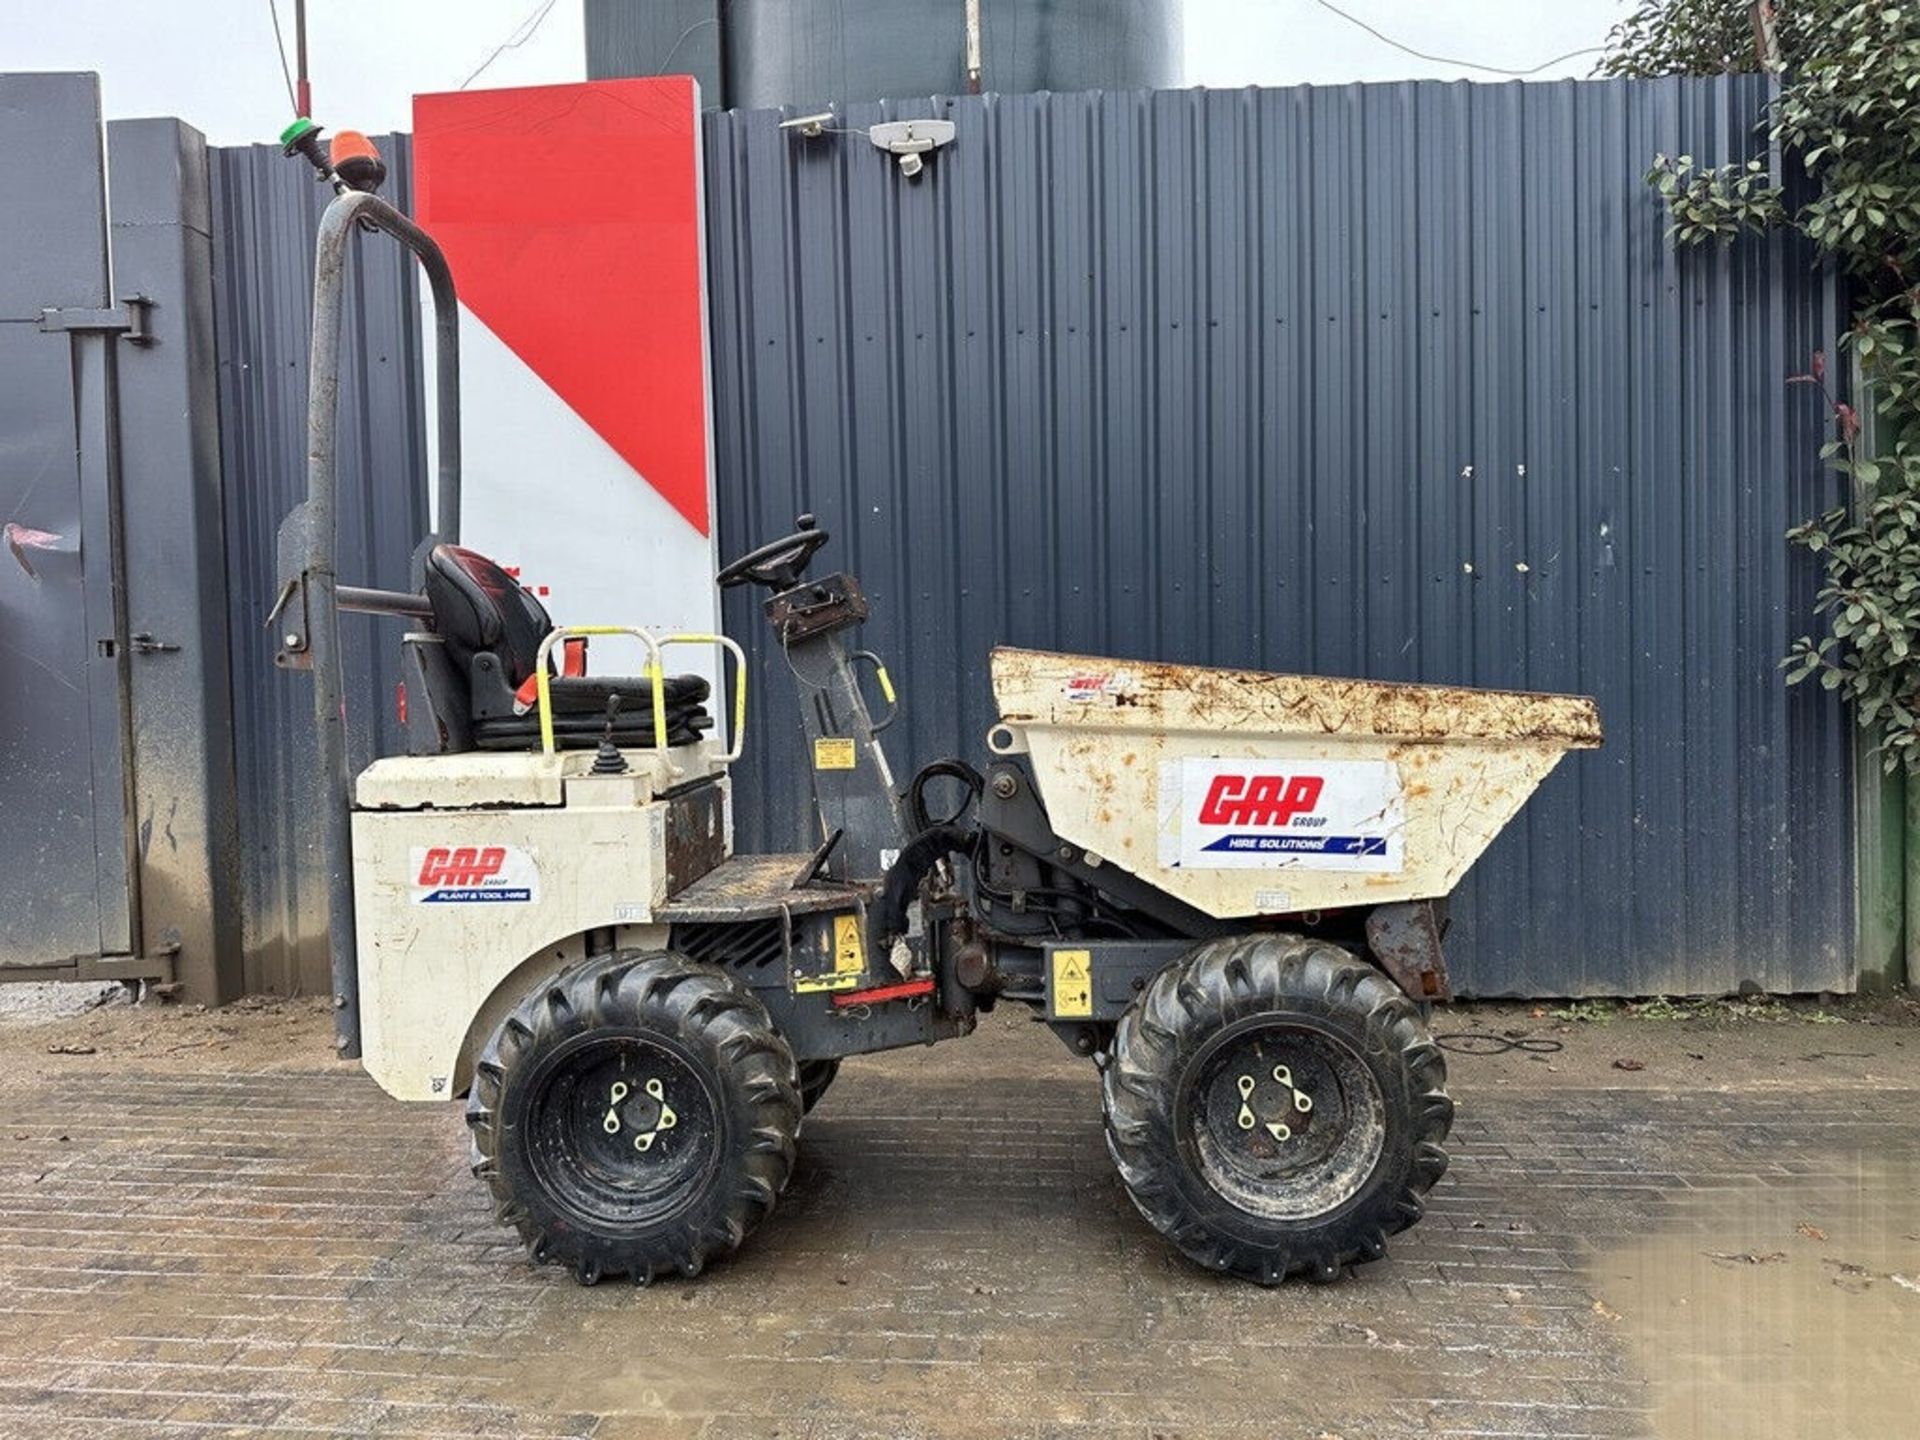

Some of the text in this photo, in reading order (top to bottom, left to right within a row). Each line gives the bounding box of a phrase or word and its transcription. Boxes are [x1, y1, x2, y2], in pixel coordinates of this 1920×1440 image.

[1198, 775, 1325, 826] GAP
[1292, 816, 1328, 828] GROUP
[1229, 837, 1325, 850] HIRE SOLUTIONS
[437, 891, 469, 900] PLANT
[479, 891, 503, 900] TOOL
[504, 890, 528, 899] HIRE
